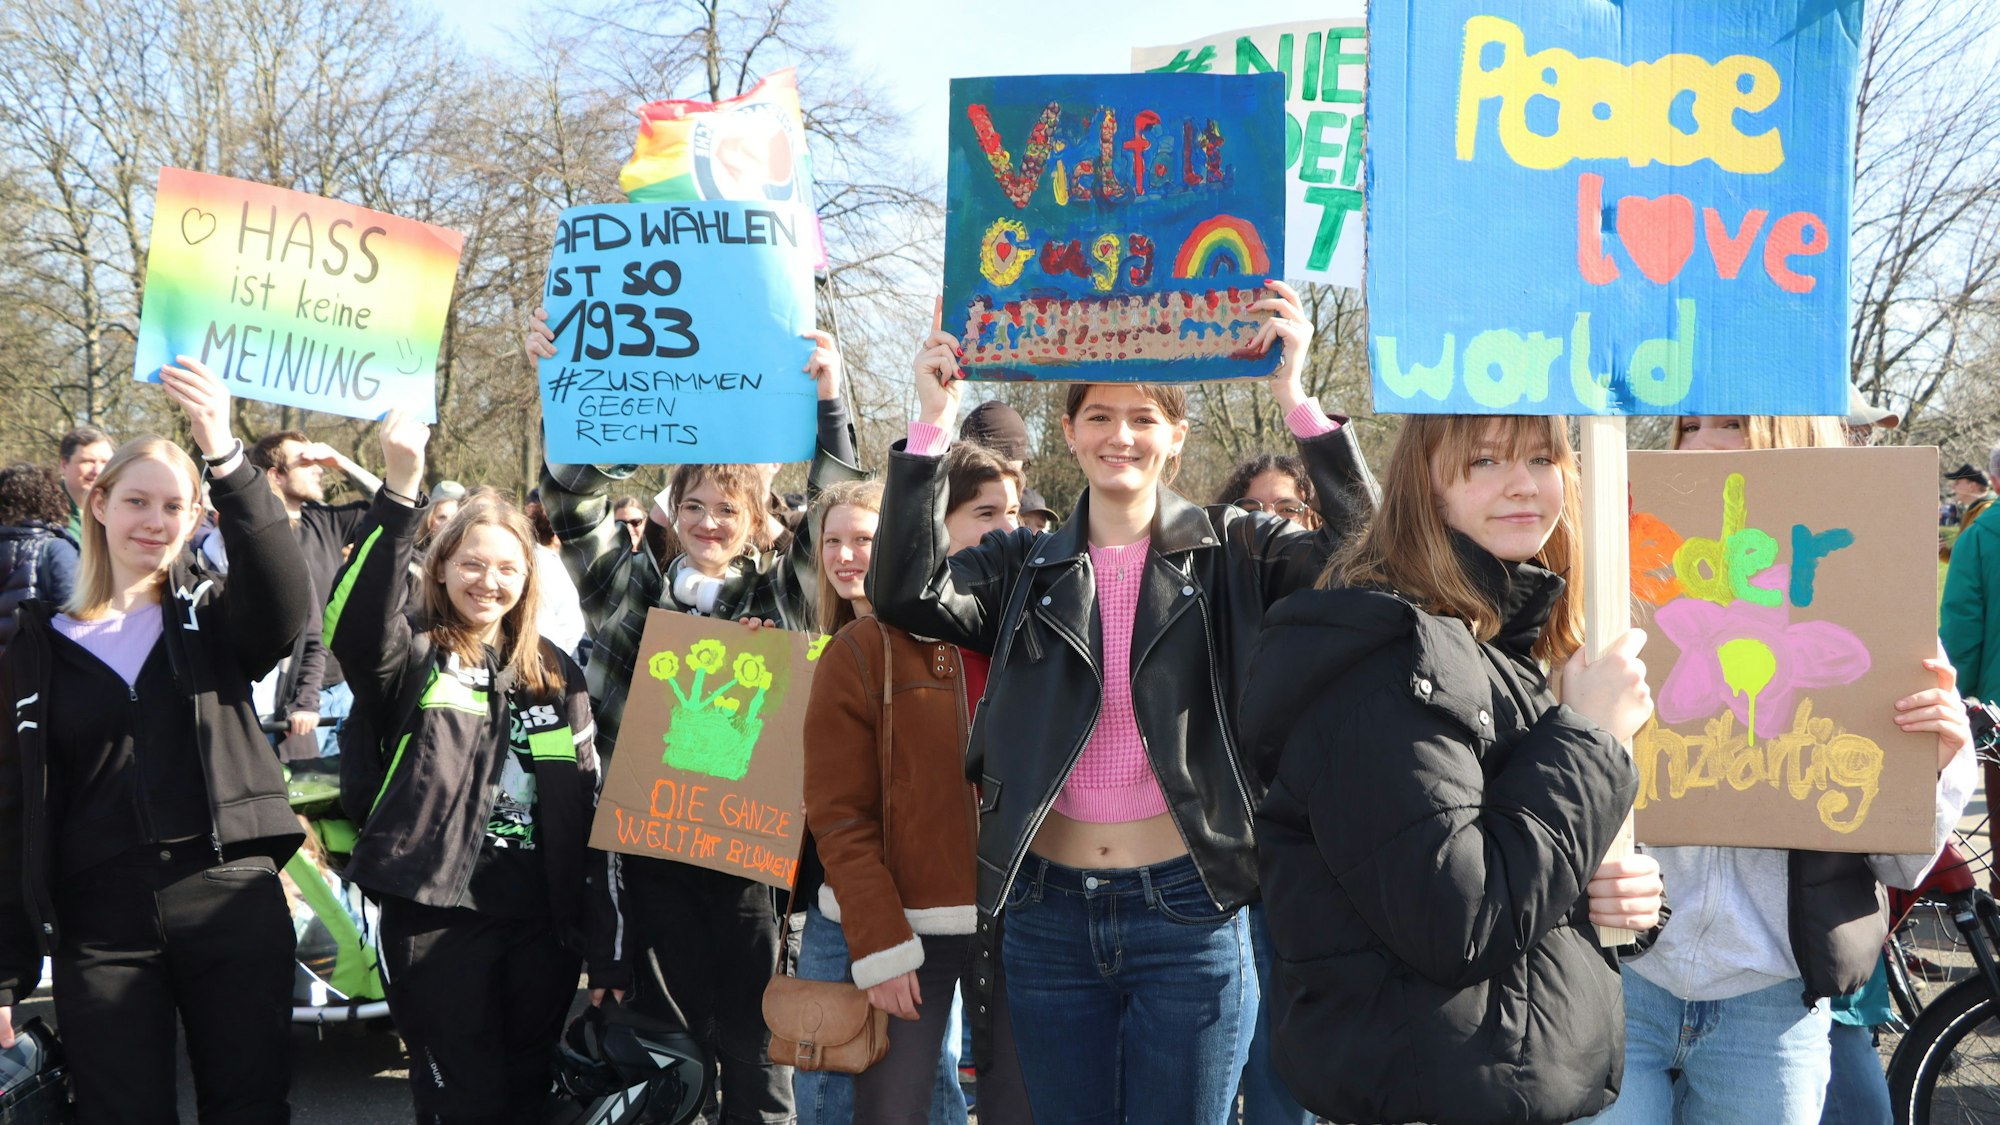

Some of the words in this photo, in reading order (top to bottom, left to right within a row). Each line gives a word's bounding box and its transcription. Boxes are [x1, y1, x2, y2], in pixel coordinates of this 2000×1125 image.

[237, 200, 388, 284] HASS
[552, 212, 632, 254] AFD
[230, 266, 276, 311] ist
[296, 278, 372, 331] keine
[546, 265, 602, 297] IST
[621, 259, 682, 297] SO
[201, 319, 381, 401] MEINUNG
[549, 299, 701, 363] 1933
[1376, 298, 1697, 411] world
[547, 366, 763, 404] #ZUSAMMEN
[578, 395, 676, 417] GEGEN
[575, 418, 699, 447] RECHTS
[1628, 472, 1856, 608] eder
[650, 778, 709, 823] DIE
[719, 793, 792, 838] GANZE
[615, 808, 690, 853] WELT
[690, 826, 723, 859] HAT
[726, 838, 800, 887] BLUMEN
